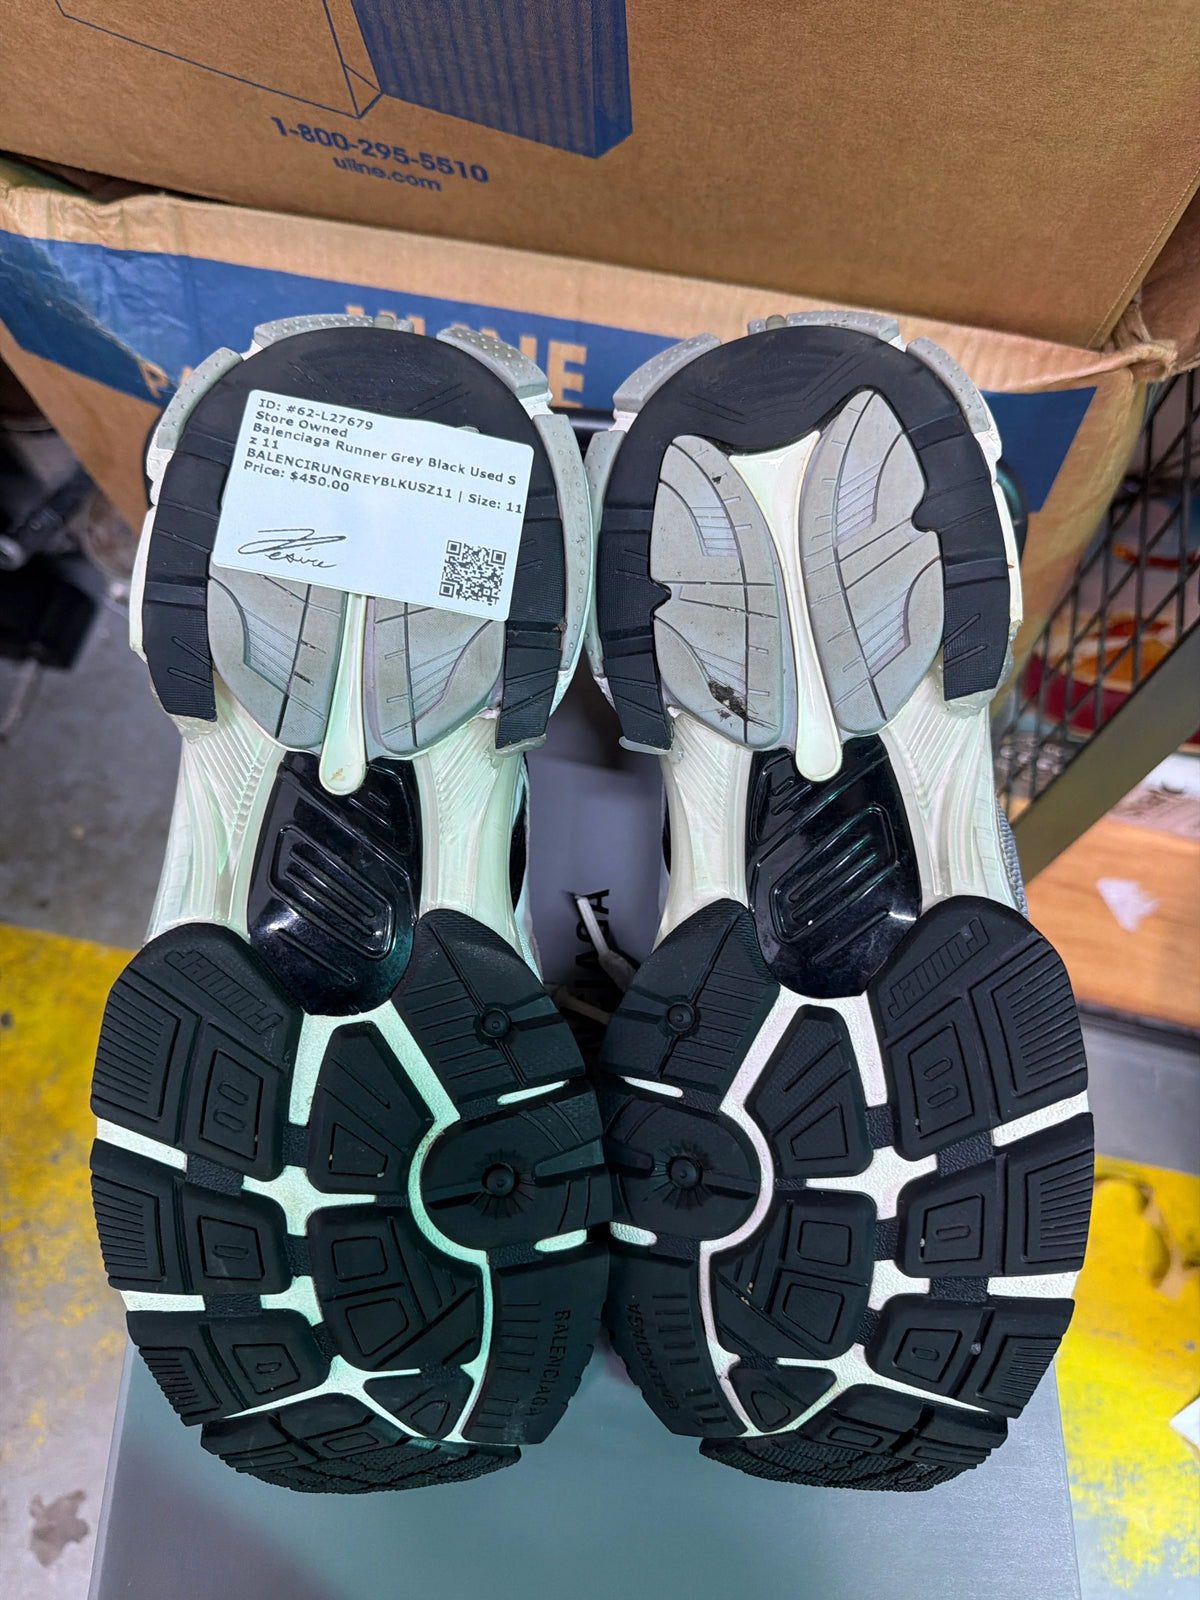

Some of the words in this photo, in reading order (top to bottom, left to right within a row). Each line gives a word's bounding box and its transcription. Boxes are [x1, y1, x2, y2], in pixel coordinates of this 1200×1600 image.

[271, 116, 489, 183] 1-800-295-5510
[332, 157, 442, 192] uline.com
[255, 411, 294, 427] Store
[298, 419, 348, 438] Owned
[258, 398, 281, 411] ID:
[286, 404, 373, 431] #62-L27679
[249, 436, 258, 445] z
[262, 437, 279, 449] 11
[253, 422, 330, 447] Balenciaga
[335, 440, 387, 460] Runner
[391, 452, 424, 467] Grey
[428, 457, 466, 475] Black
[470, 466, 504, 483] Used
[507, 475, 517, 485] S
[243, 460, 285, 478] Price:
[290, 471, 350, 492] $450.00
[246, 447, 452, 499] BALENCIRUNGREYBLKUSZ11
[468, 493, 501, 509] Size:
[506, 502, 522, 514] 11
[524, 1308, 572, 1416] BALENCIAGA
